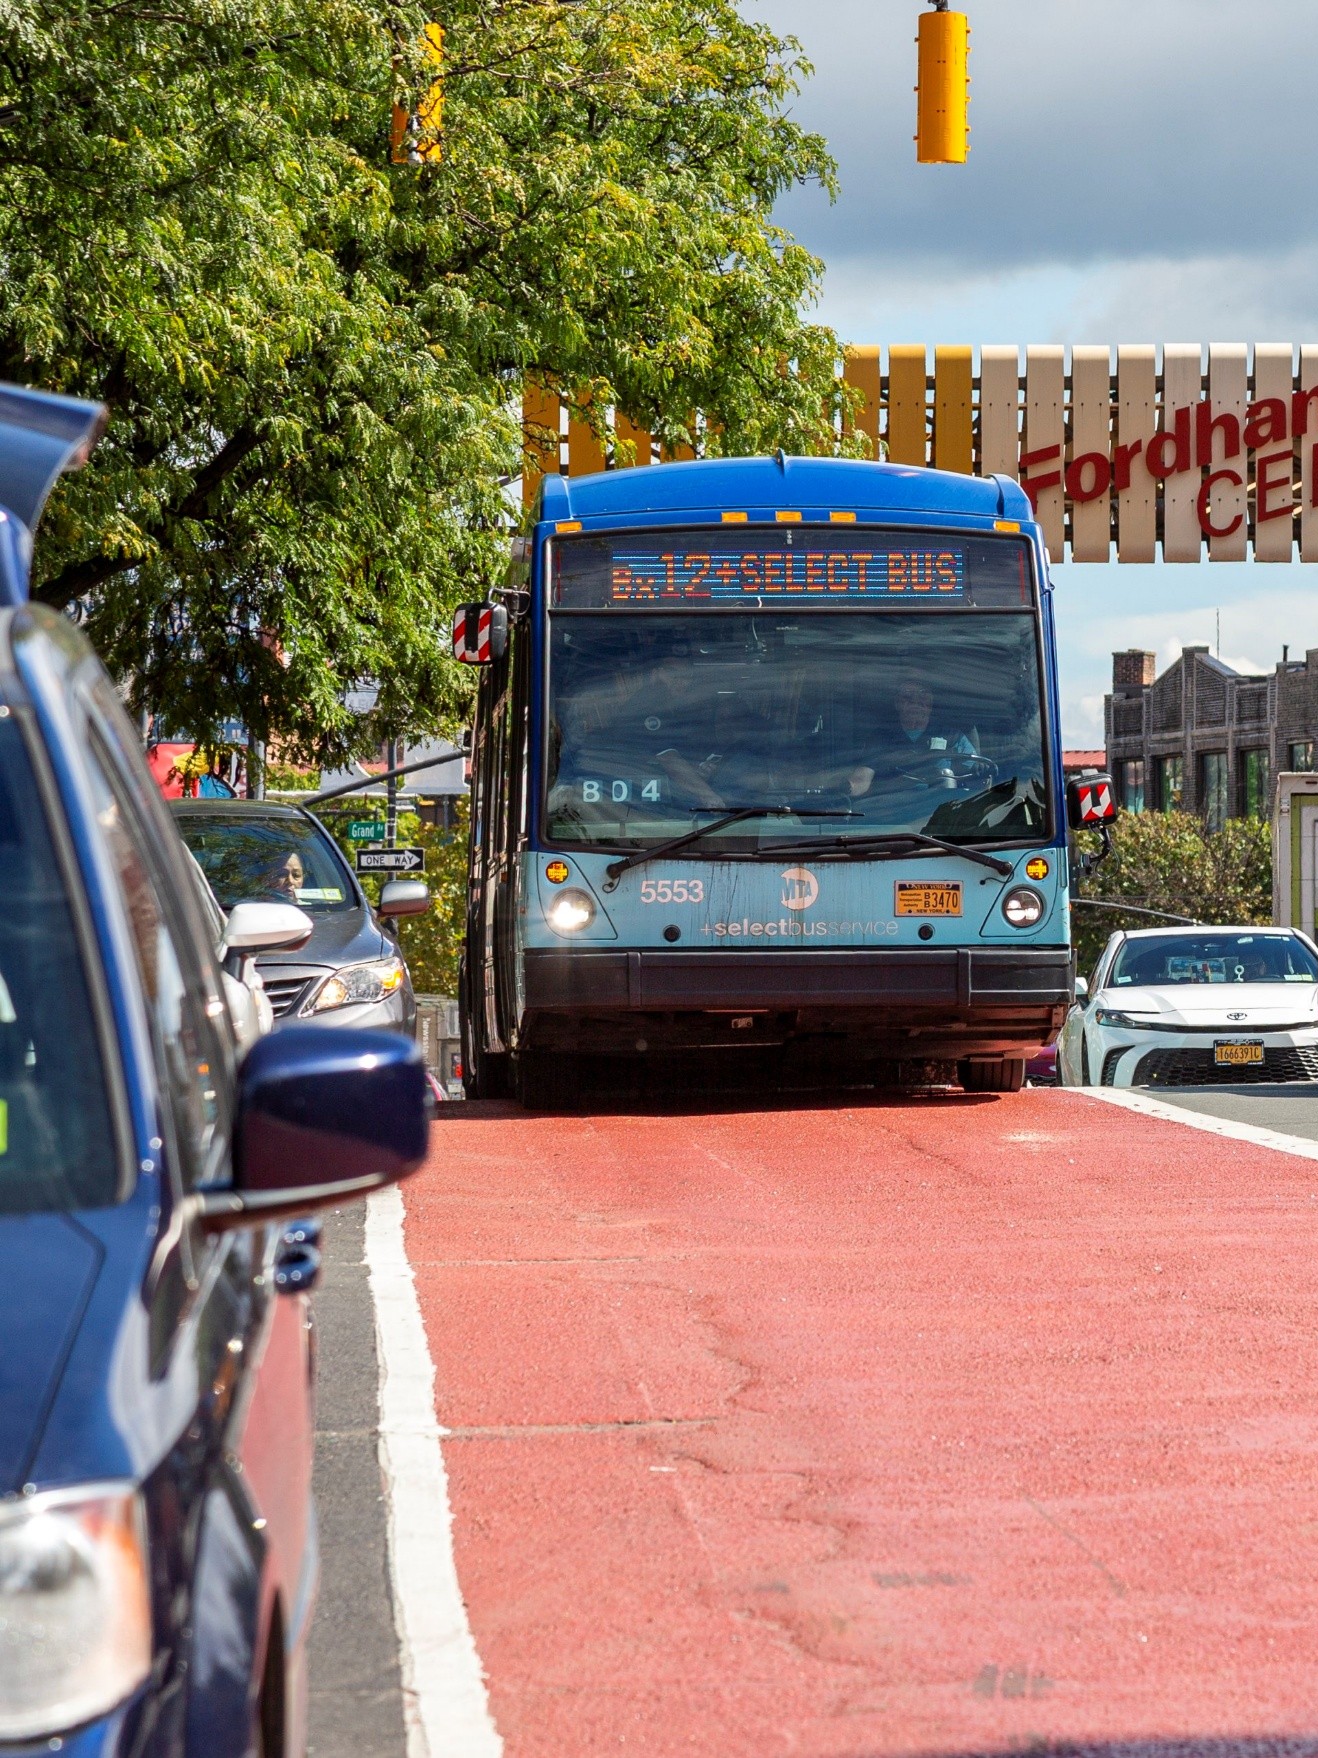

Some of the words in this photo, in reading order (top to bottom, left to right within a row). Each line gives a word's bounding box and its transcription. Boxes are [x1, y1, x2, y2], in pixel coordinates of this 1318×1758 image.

[888, 553, 957, 591] BUS
[351, 824, 375, 838] Grand
[366, 856, 385, 865] ONE
[394, 856, 414, 865] WAY
[640, 879, 705, 904] 5553
[932, 892, 959, 908] 3470
[1219, 1047, 1260, 1060] T666391C
